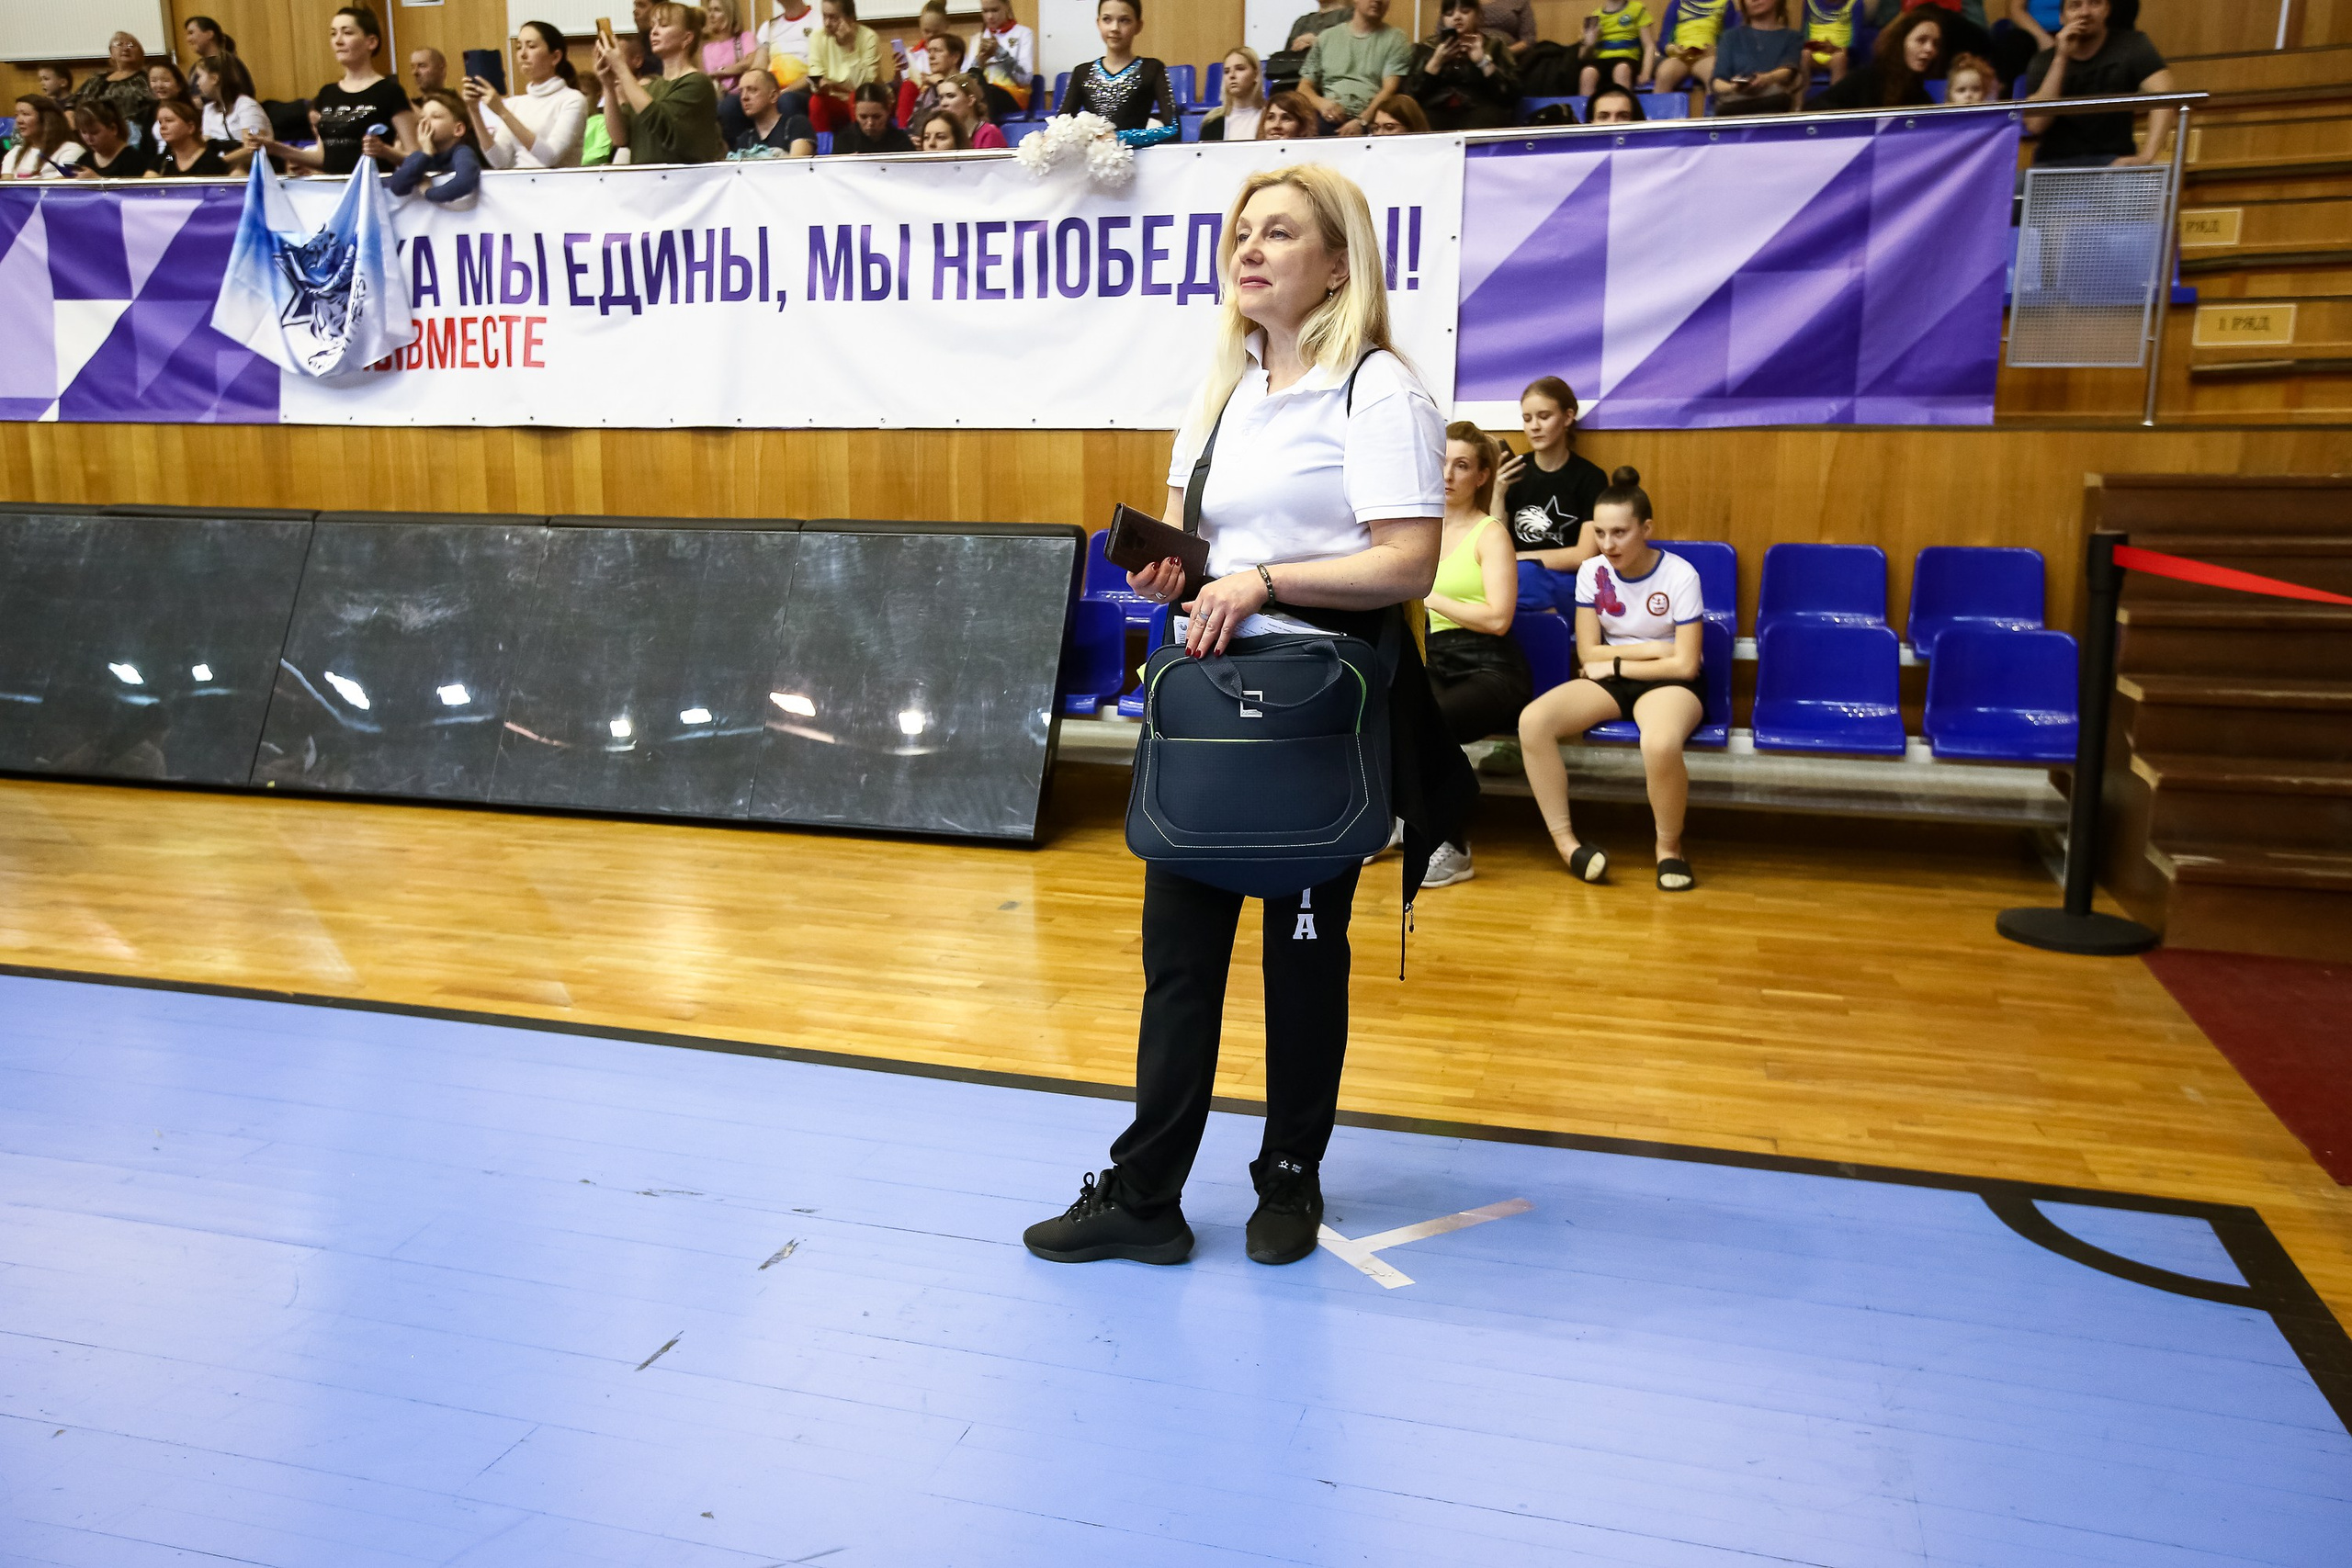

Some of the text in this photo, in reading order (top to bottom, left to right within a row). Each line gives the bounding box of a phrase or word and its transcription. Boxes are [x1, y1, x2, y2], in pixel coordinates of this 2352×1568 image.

[457, 232, 549, 306] МЫ
[564, 226, 786, 315] ЕДИНЫ,
[808, 224, 910, 301] МЫ
[932, 206, 1421, 306] НЕПОБЕД!
[2232, 315, 2270, 332] РЯД
